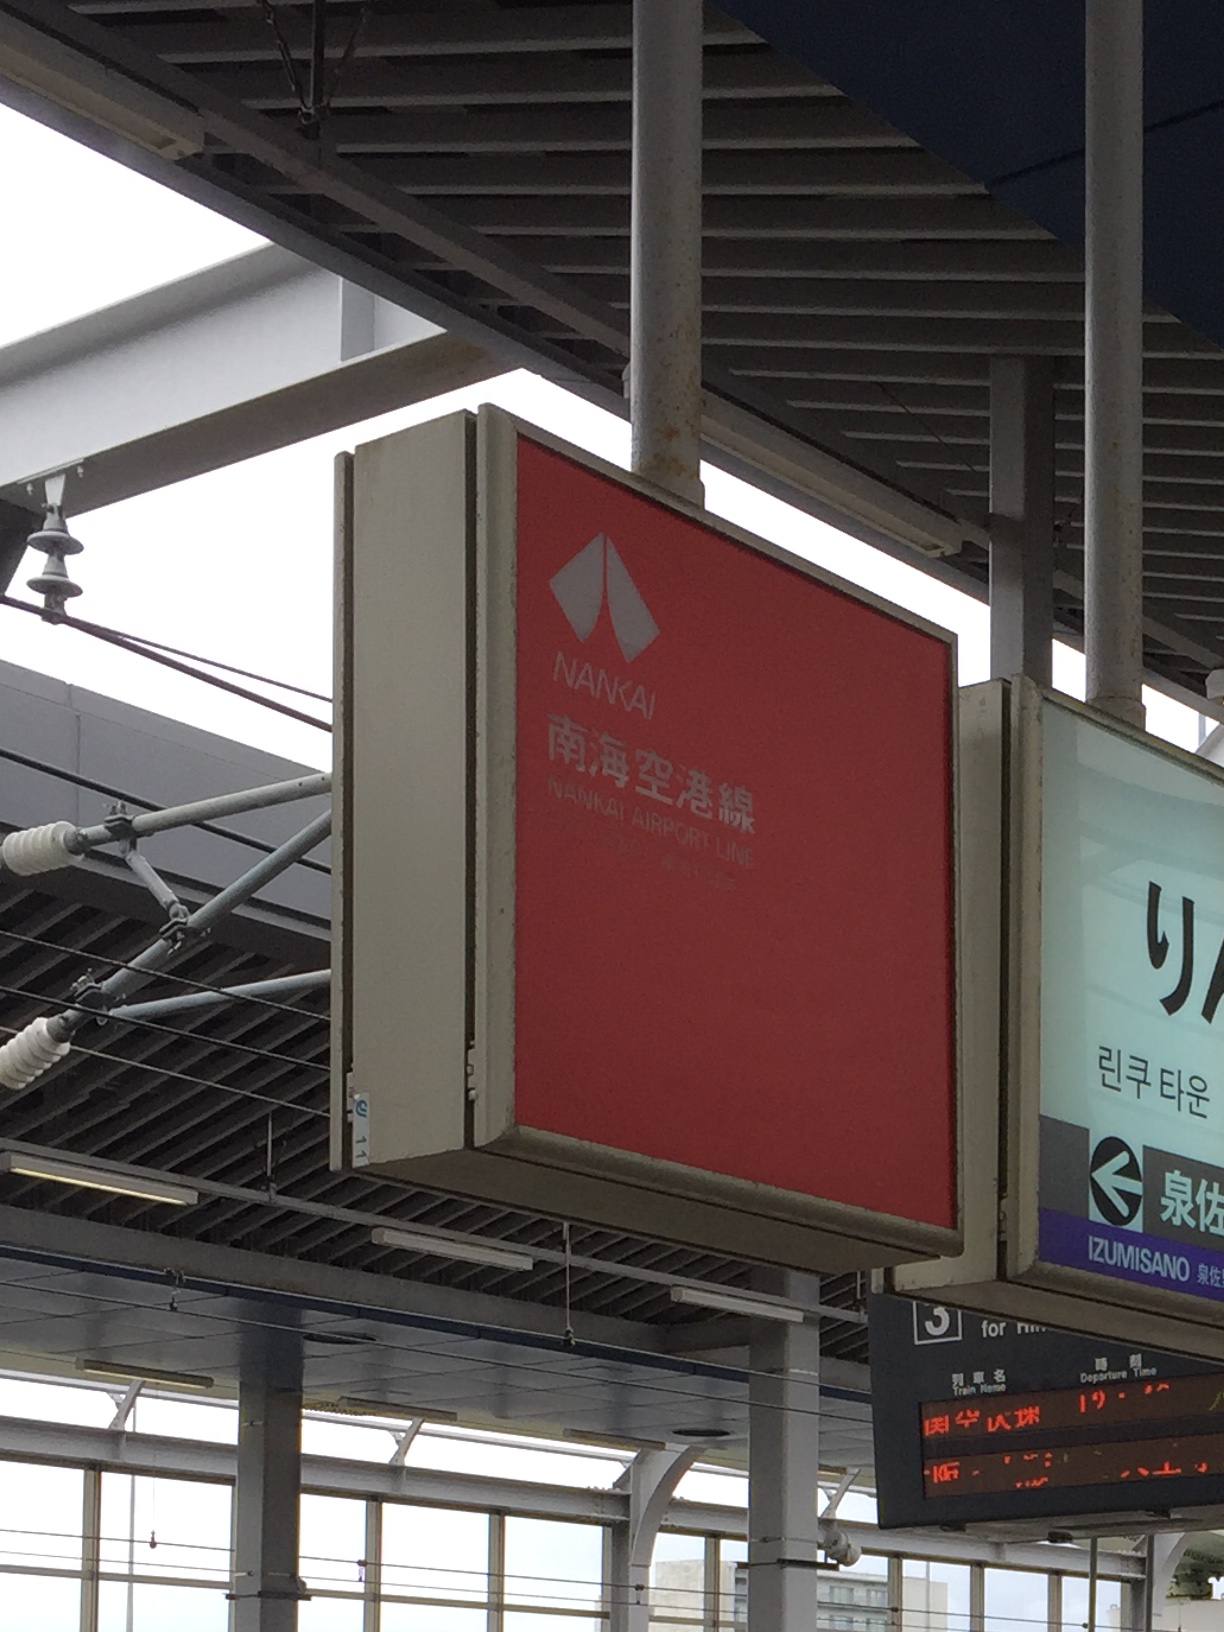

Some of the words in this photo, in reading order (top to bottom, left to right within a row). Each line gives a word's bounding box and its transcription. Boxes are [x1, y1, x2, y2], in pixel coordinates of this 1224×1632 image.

[553, 651, 656, 720] NANKAI
[548, 712, 755, 833] 南海空港線
[631, 807, 710, 850] AIRPORT
[716, 836, 754, 870] LINE
[1099, 1045, 1151, 1099] 린쿠
[1160, 1068, 1210, 1119] 타운
[1088, 1236, 1190, 1283] IZUMISANO
[982, 1320, 1006, 1338] for
